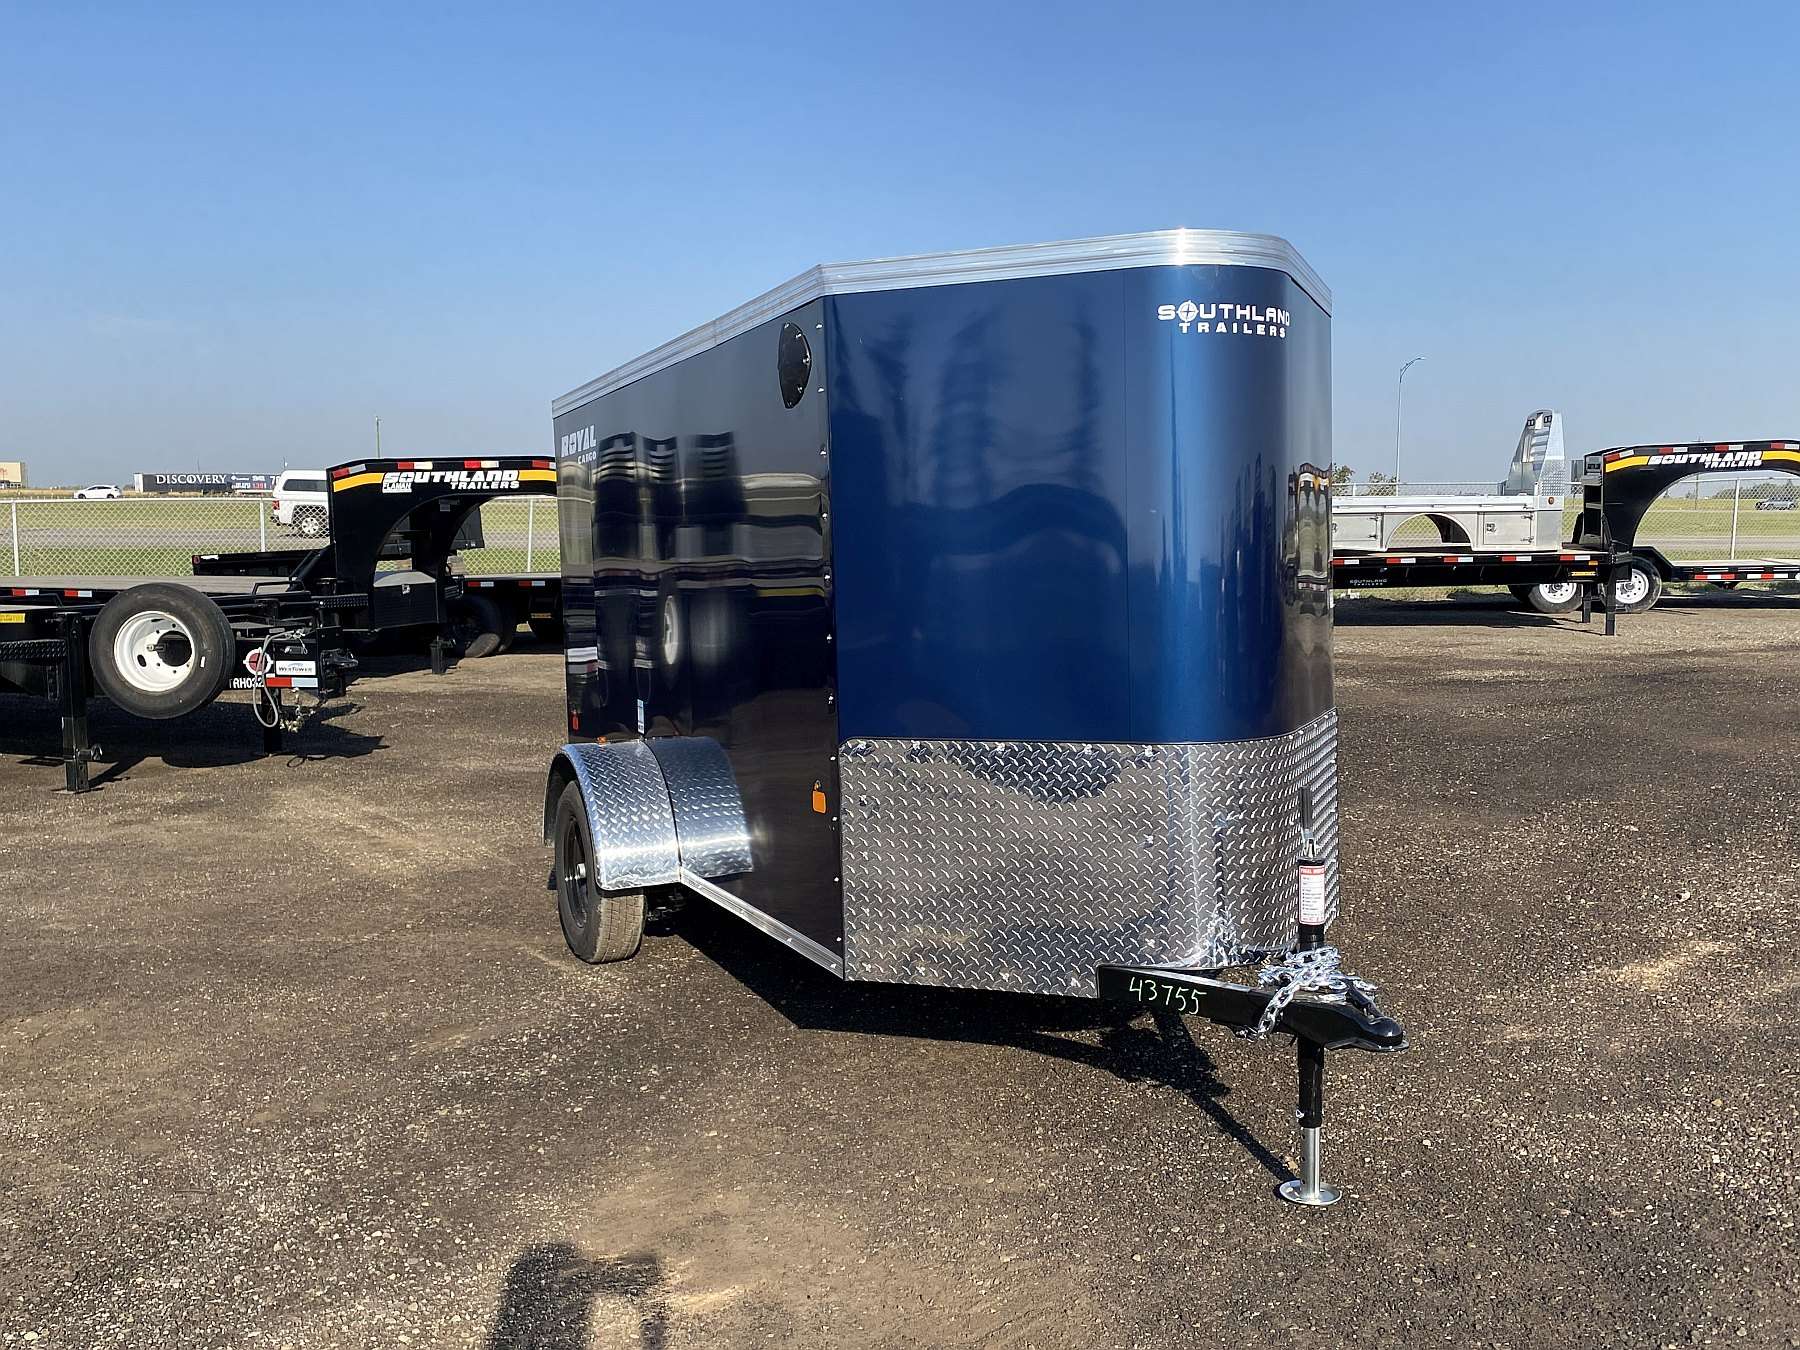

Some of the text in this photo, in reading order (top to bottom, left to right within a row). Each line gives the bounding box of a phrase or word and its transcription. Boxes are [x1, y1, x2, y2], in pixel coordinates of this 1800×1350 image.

[1157, 300, 1290, 327] SOUTHLAND
[1179, 321, 1287, 338] TRAILERS
[561, 424, 597, 458] ROYAL
[577, 450, 597, 465] CARGO
[1647, 451, 1762, 466] SOUTHLAND
[1704, 459, 1762, 469] TRAILERS
[156, 474, 227, 484] DISCOVERY
[383, 470, 519, 483] SOUTHLAND
[382, 482, 412, 490] FLAMAN
[450, 481, 520, 490] TRAILERS
[1129, 976, 1208, 1015] 43755
